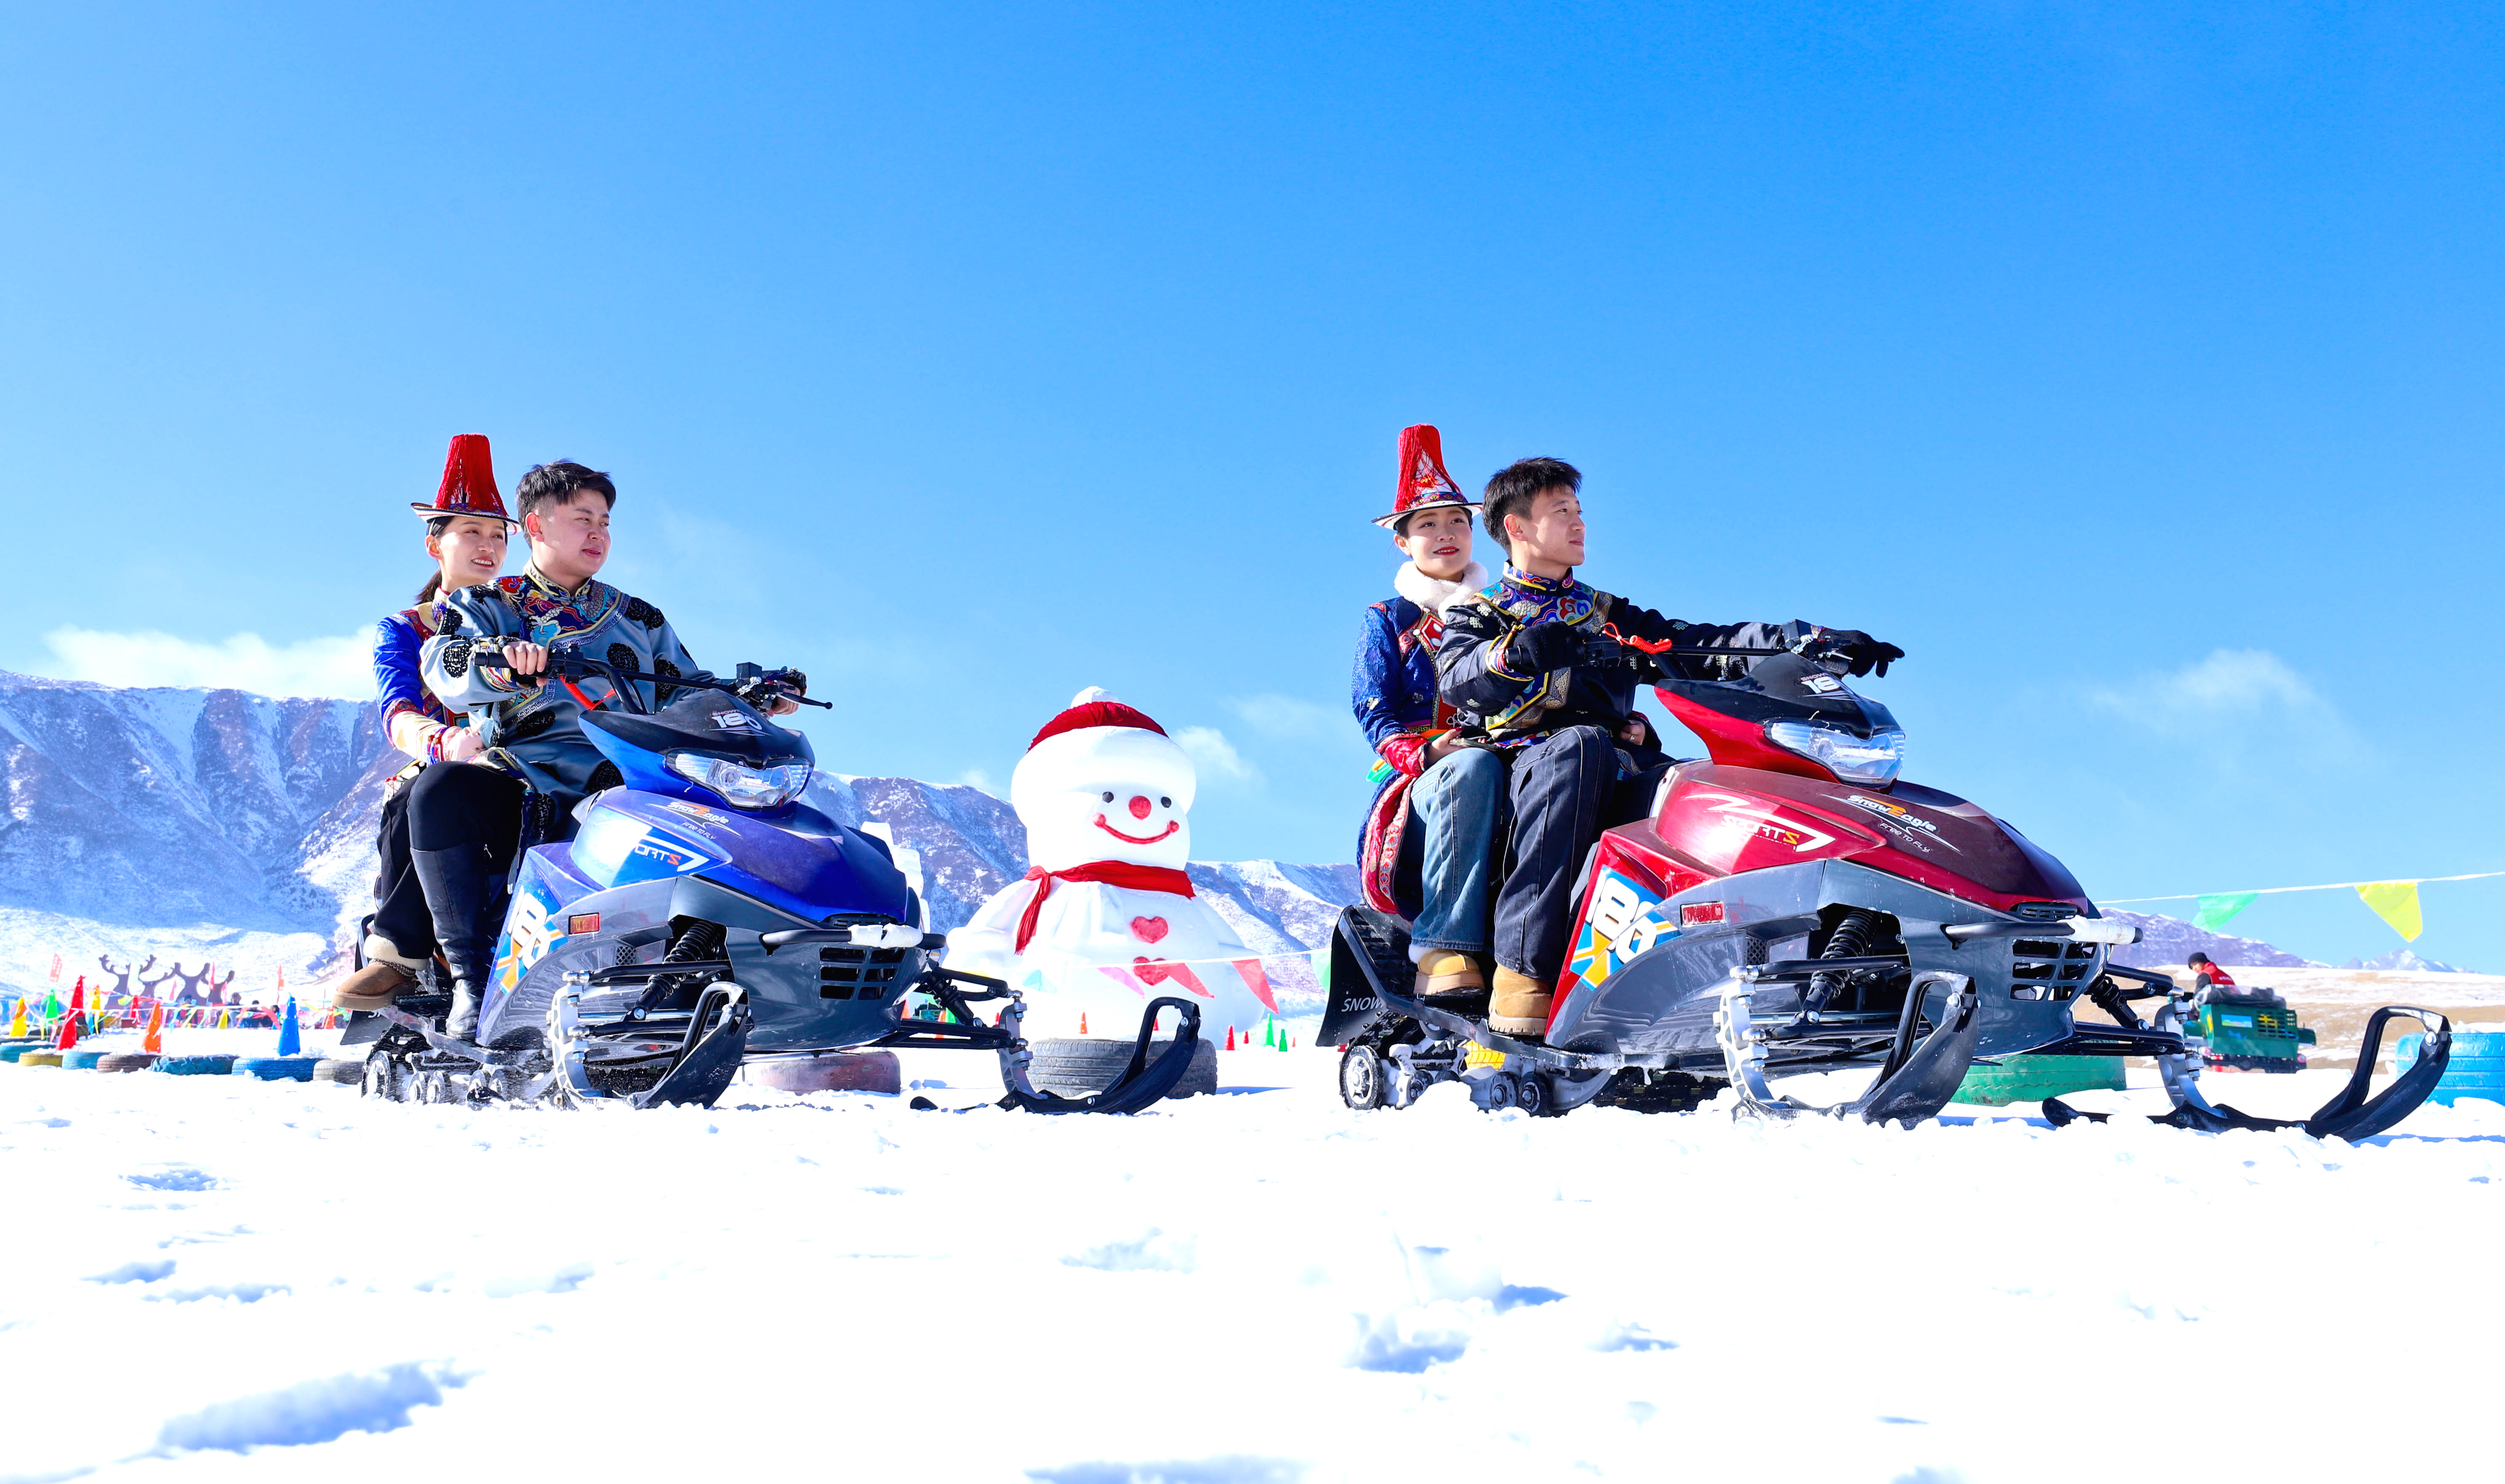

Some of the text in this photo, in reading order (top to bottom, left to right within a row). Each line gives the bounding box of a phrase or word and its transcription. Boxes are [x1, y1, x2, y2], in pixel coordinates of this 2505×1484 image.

[711, 712, 762, 730] 180
[507, 885, 555, 970] 180
[1585, 869, 1658, 964] 180
